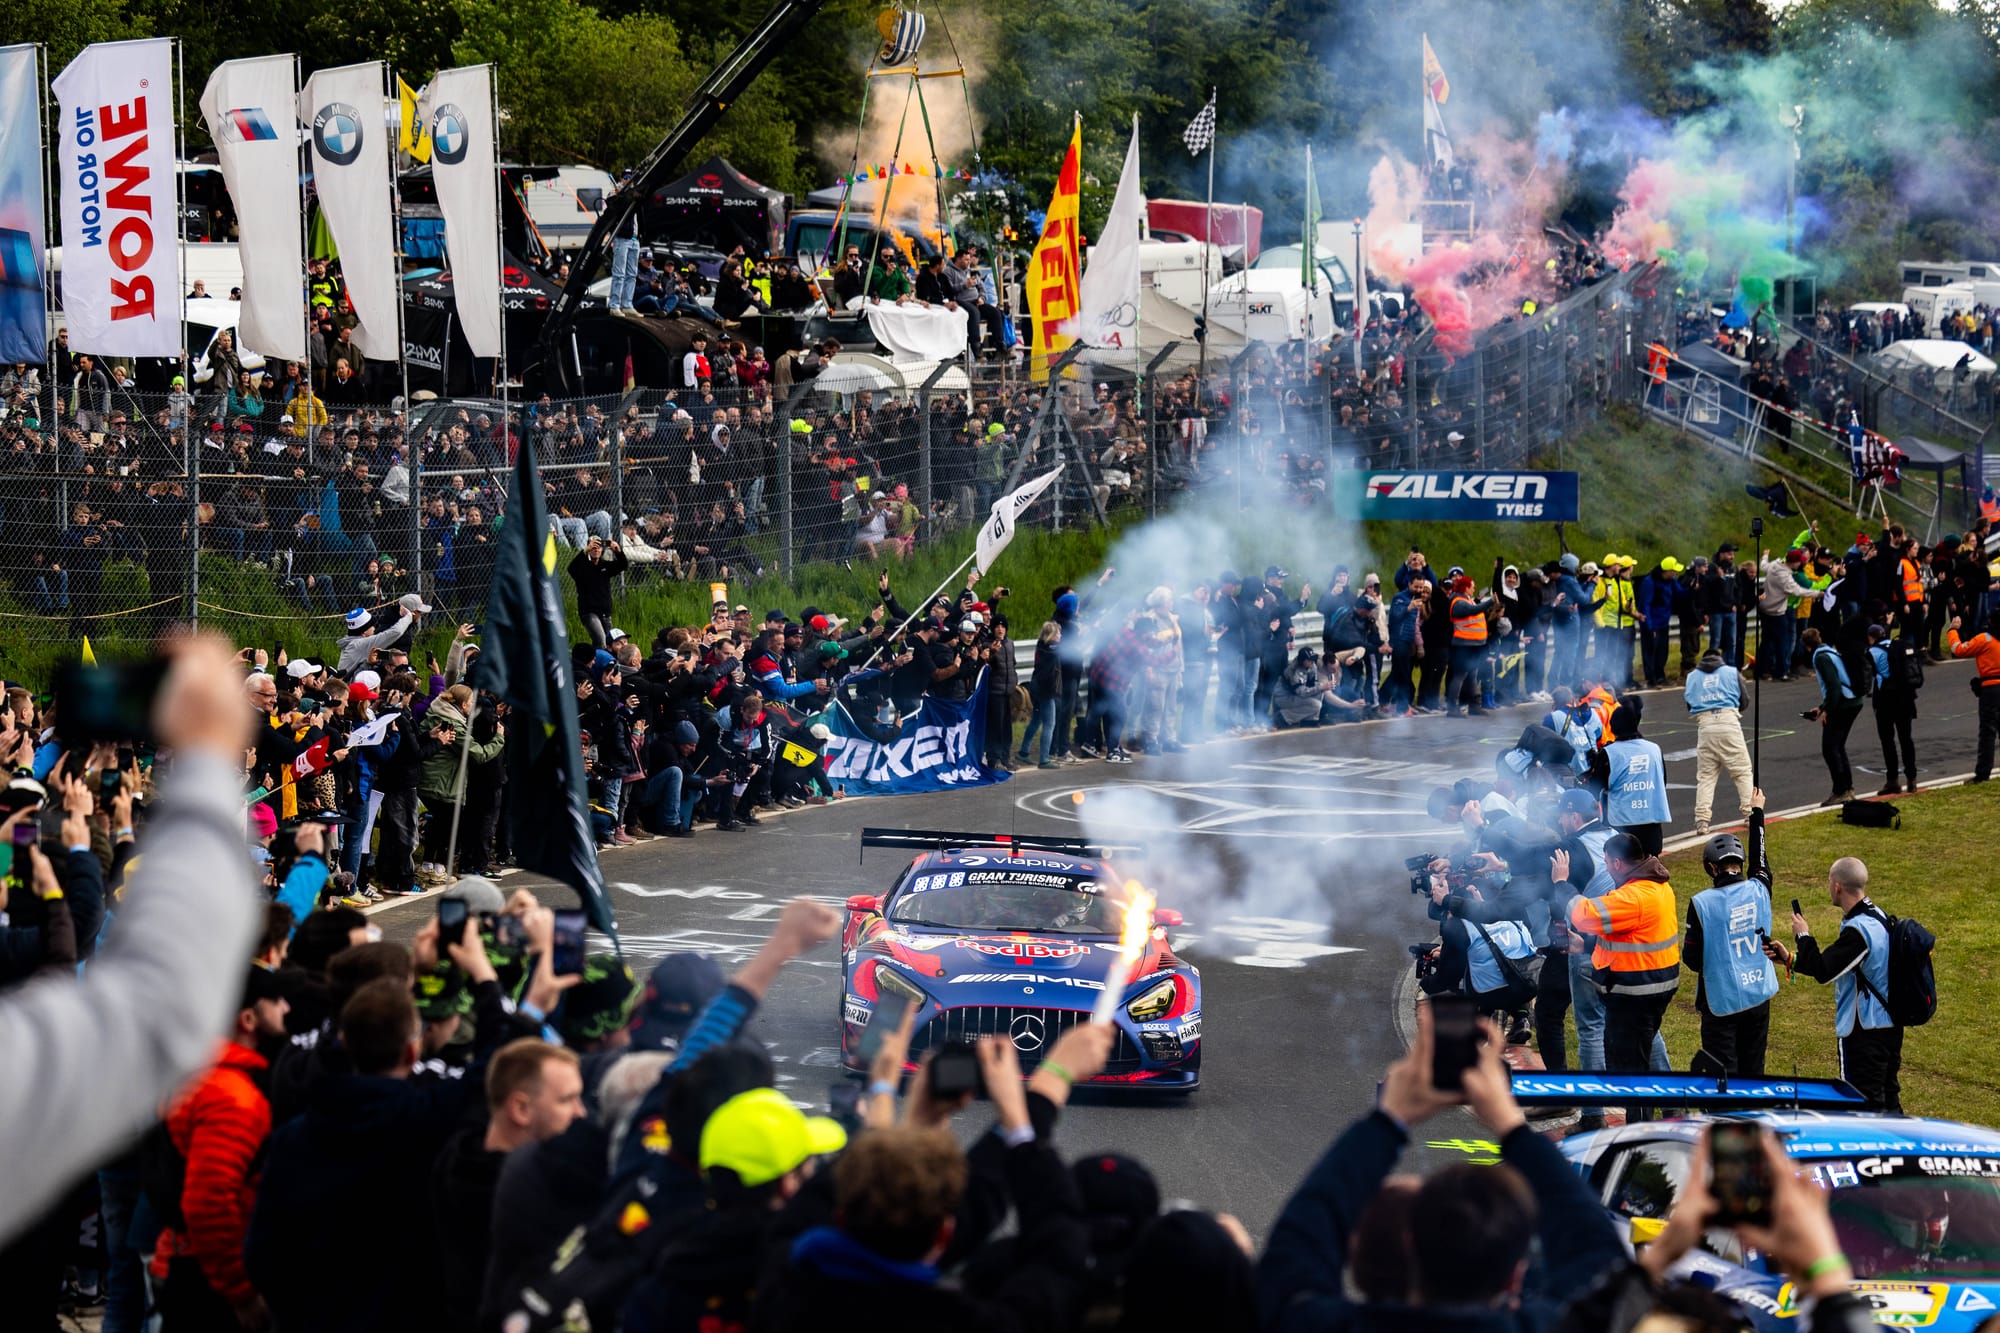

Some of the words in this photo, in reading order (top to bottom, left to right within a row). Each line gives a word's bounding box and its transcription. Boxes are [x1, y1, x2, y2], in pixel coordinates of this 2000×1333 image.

[666, 197, 701, 205] 24MX
[723, 199, 758, 207] 24MX
[424, 297, 445, 310] 24MX
[1366, 475, 1548, 500] FALKEN
[1496, 503, 1543, 516] TYRES
[1623, 781, 1655, 792] MEDIA
[1631, 799, 1648, 809] 831
[993, 856, 1074, 871] viaplay
[968, 871, 1006, 881] GRAN
[955, 940, 1022, 956] Red
[1026, 944, 1090, 958] Bull
[1730, 933, 1758, 959] TV
[1740, 968, 1764, 986] 362
[1838, 1142, 1916, 1152] DENT
[1918, 1157, 1982, 1172] GRAN
[1985, 1159, 2000, 1172] T
